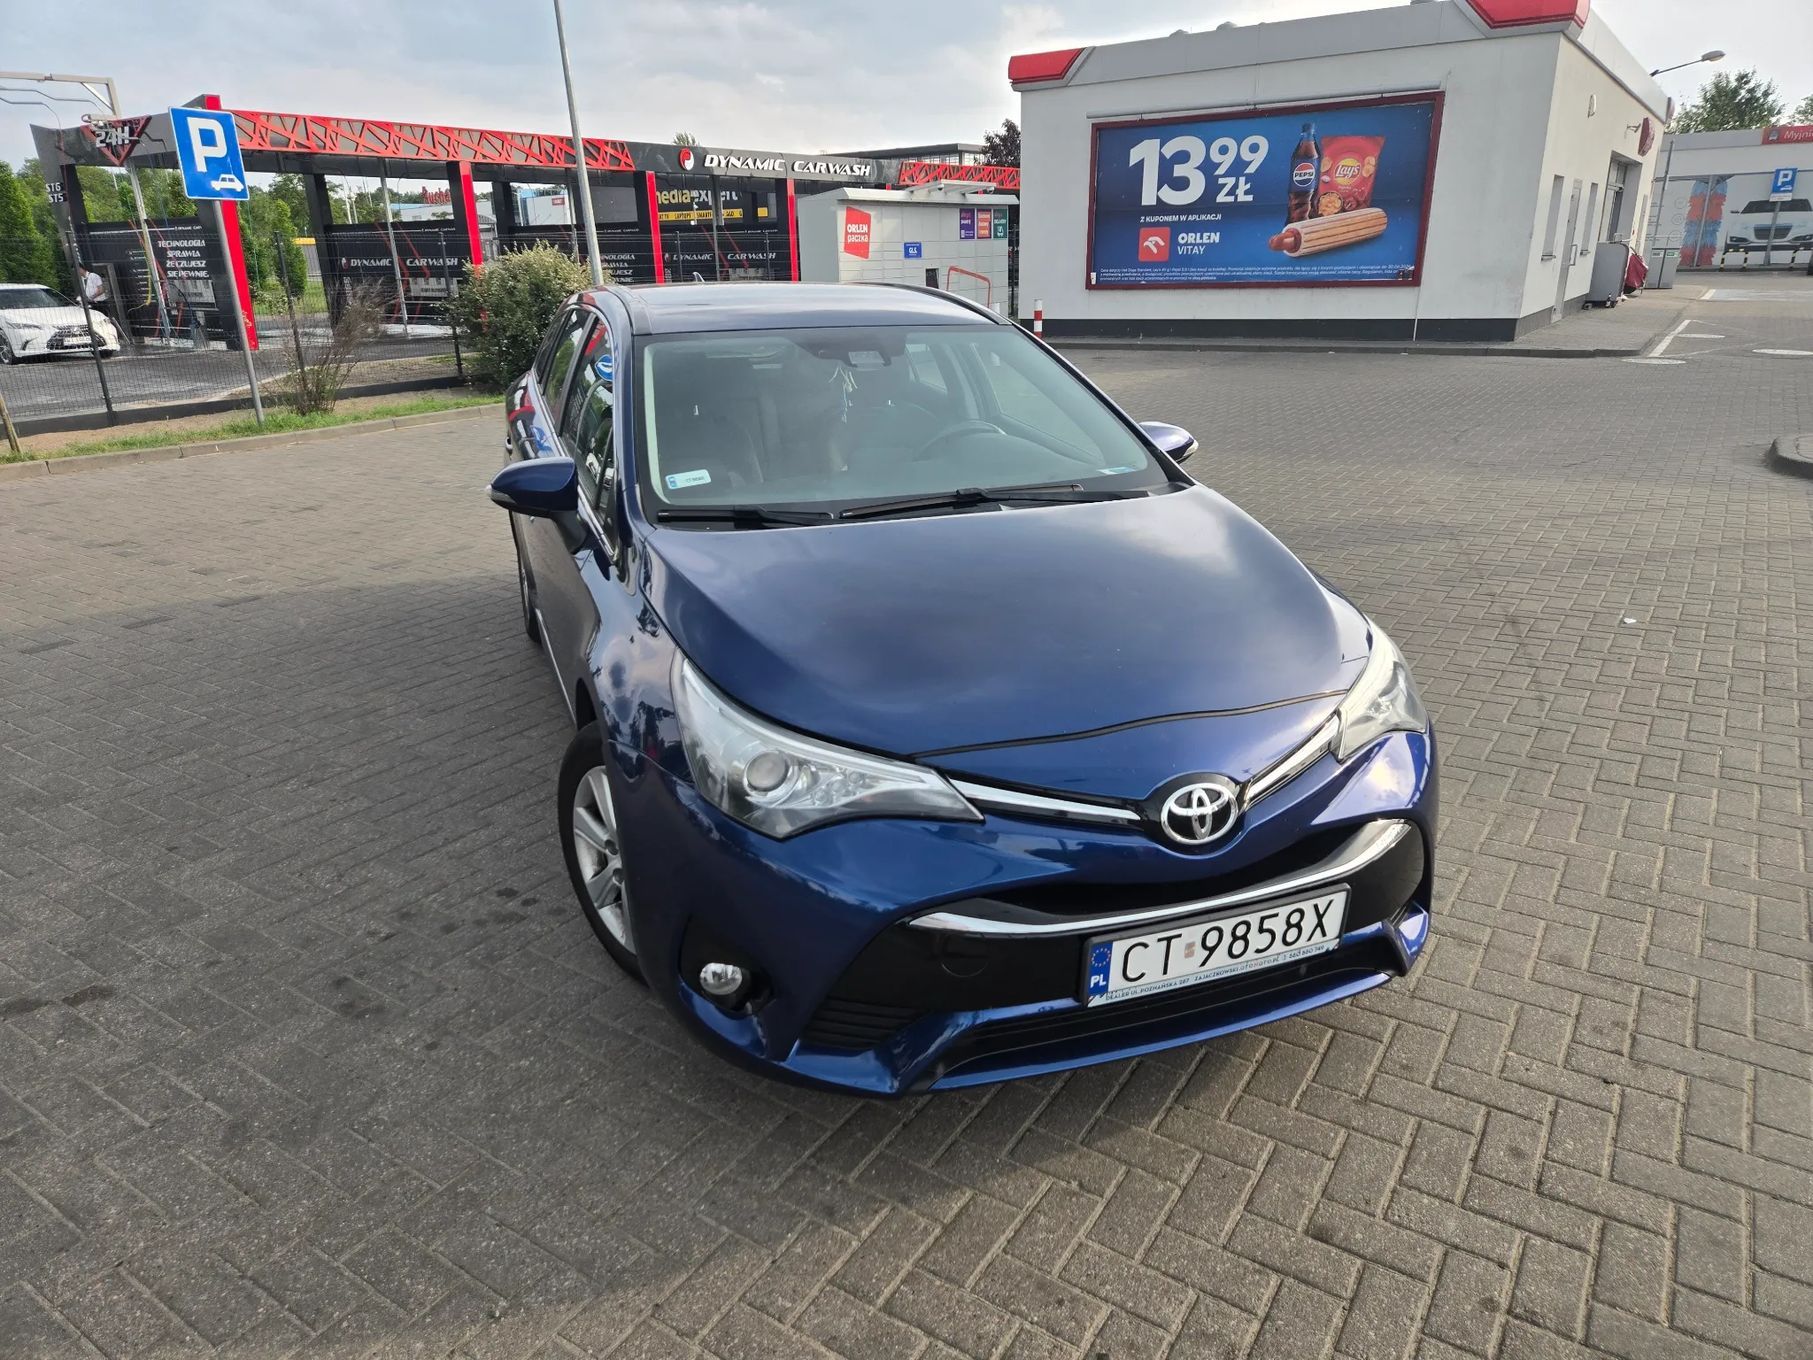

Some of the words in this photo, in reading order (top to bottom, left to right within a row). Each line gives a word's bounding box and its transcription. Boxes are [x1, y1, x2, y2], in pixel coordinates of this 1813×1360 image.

[96, 126, 129, 147] 24H
[1784, 130, 1813, 141] Myjni
[187, 117, 227, 173] P
[704, 154, 785, 172] DYNAMIC
[793, 160, 871, 177] CARWASH
[1777, 170, 1793, 187] P
[1188, 213, 1222, 221] APLIKACJI
[847, 224, 868, 233] ORLEN
[847, 234, 868, 244] paczka
[1178, 232, 1220, 244] ORLEN
[1177, 246, 1206, 255] VITAY
[351, 259, 393, 267] DYNAMIC
[1122, 933, 1183, 983] CT
[1199, 899, 1334, 968] 9858X
[1090, 973, 1107, 988] PL
